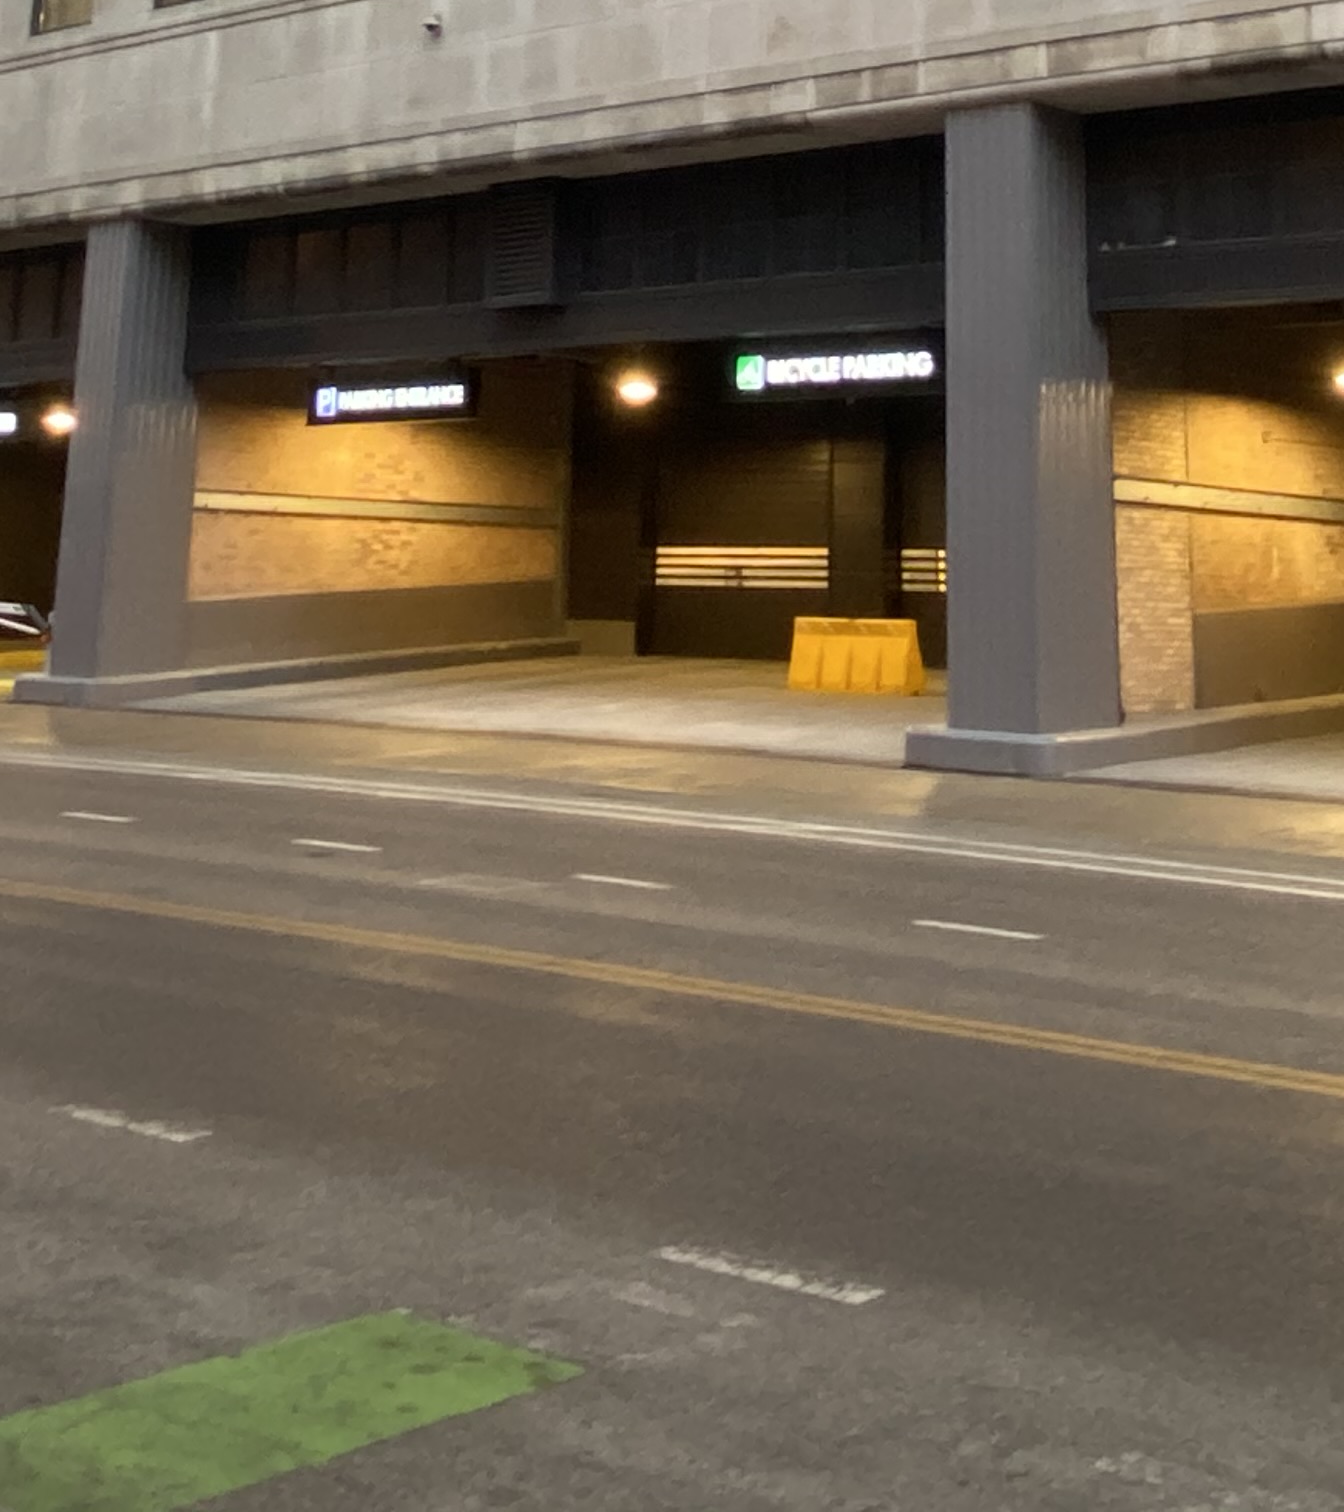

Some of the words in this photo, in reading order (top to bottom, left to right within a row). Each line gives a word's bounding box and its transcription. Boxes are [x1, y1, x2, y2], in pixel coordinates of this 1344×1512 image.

[767, 355, 840, 383] BICYCLE
[843, 351, 934, 379] PARKING
[338, 388, 393, 410] PARKING
[394, 385, 464, 408] ENTRANCE
